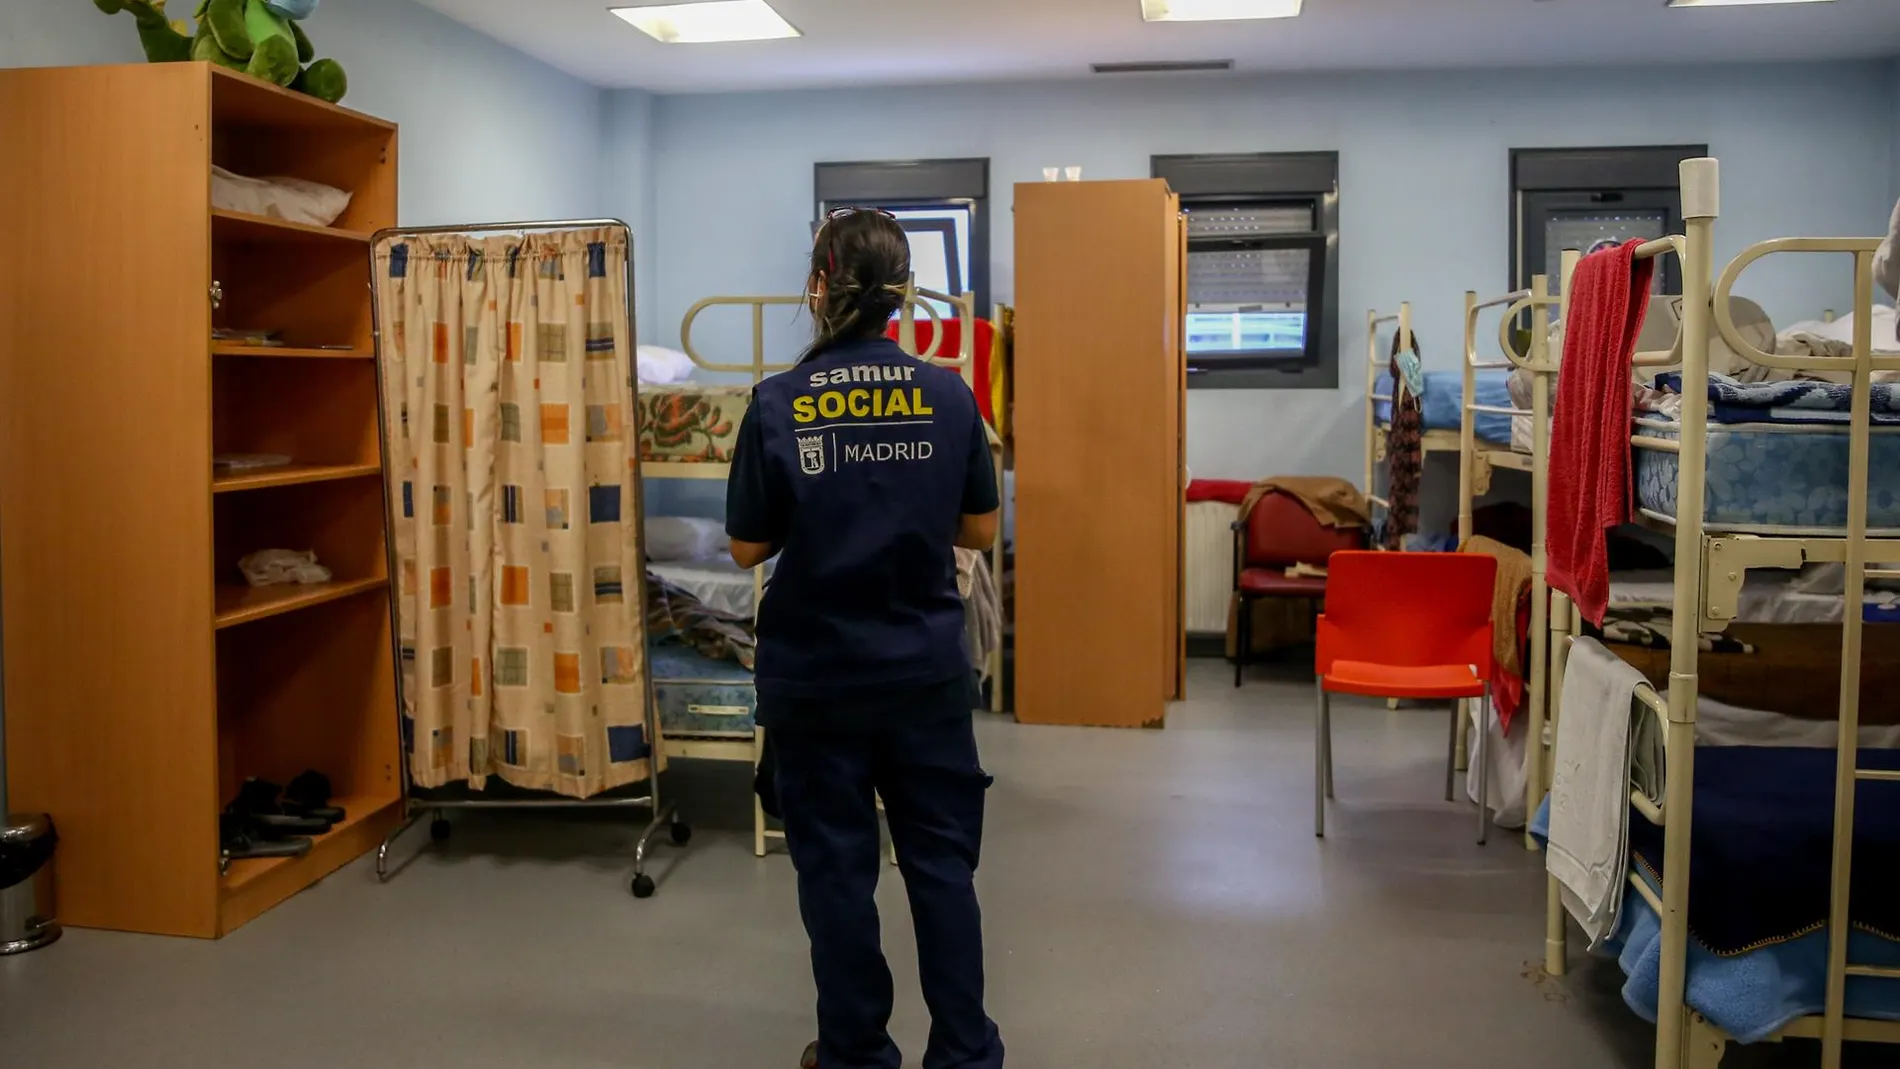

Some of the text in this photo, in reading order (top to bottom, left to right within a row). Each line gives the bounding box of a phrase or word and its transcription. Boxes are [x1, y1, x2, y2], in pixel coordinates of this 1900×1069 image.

[810, 364, 915, 387] samur
[793, 388, 933, 423] SOCIAL
[845, 441, 933, 462] MADRID
